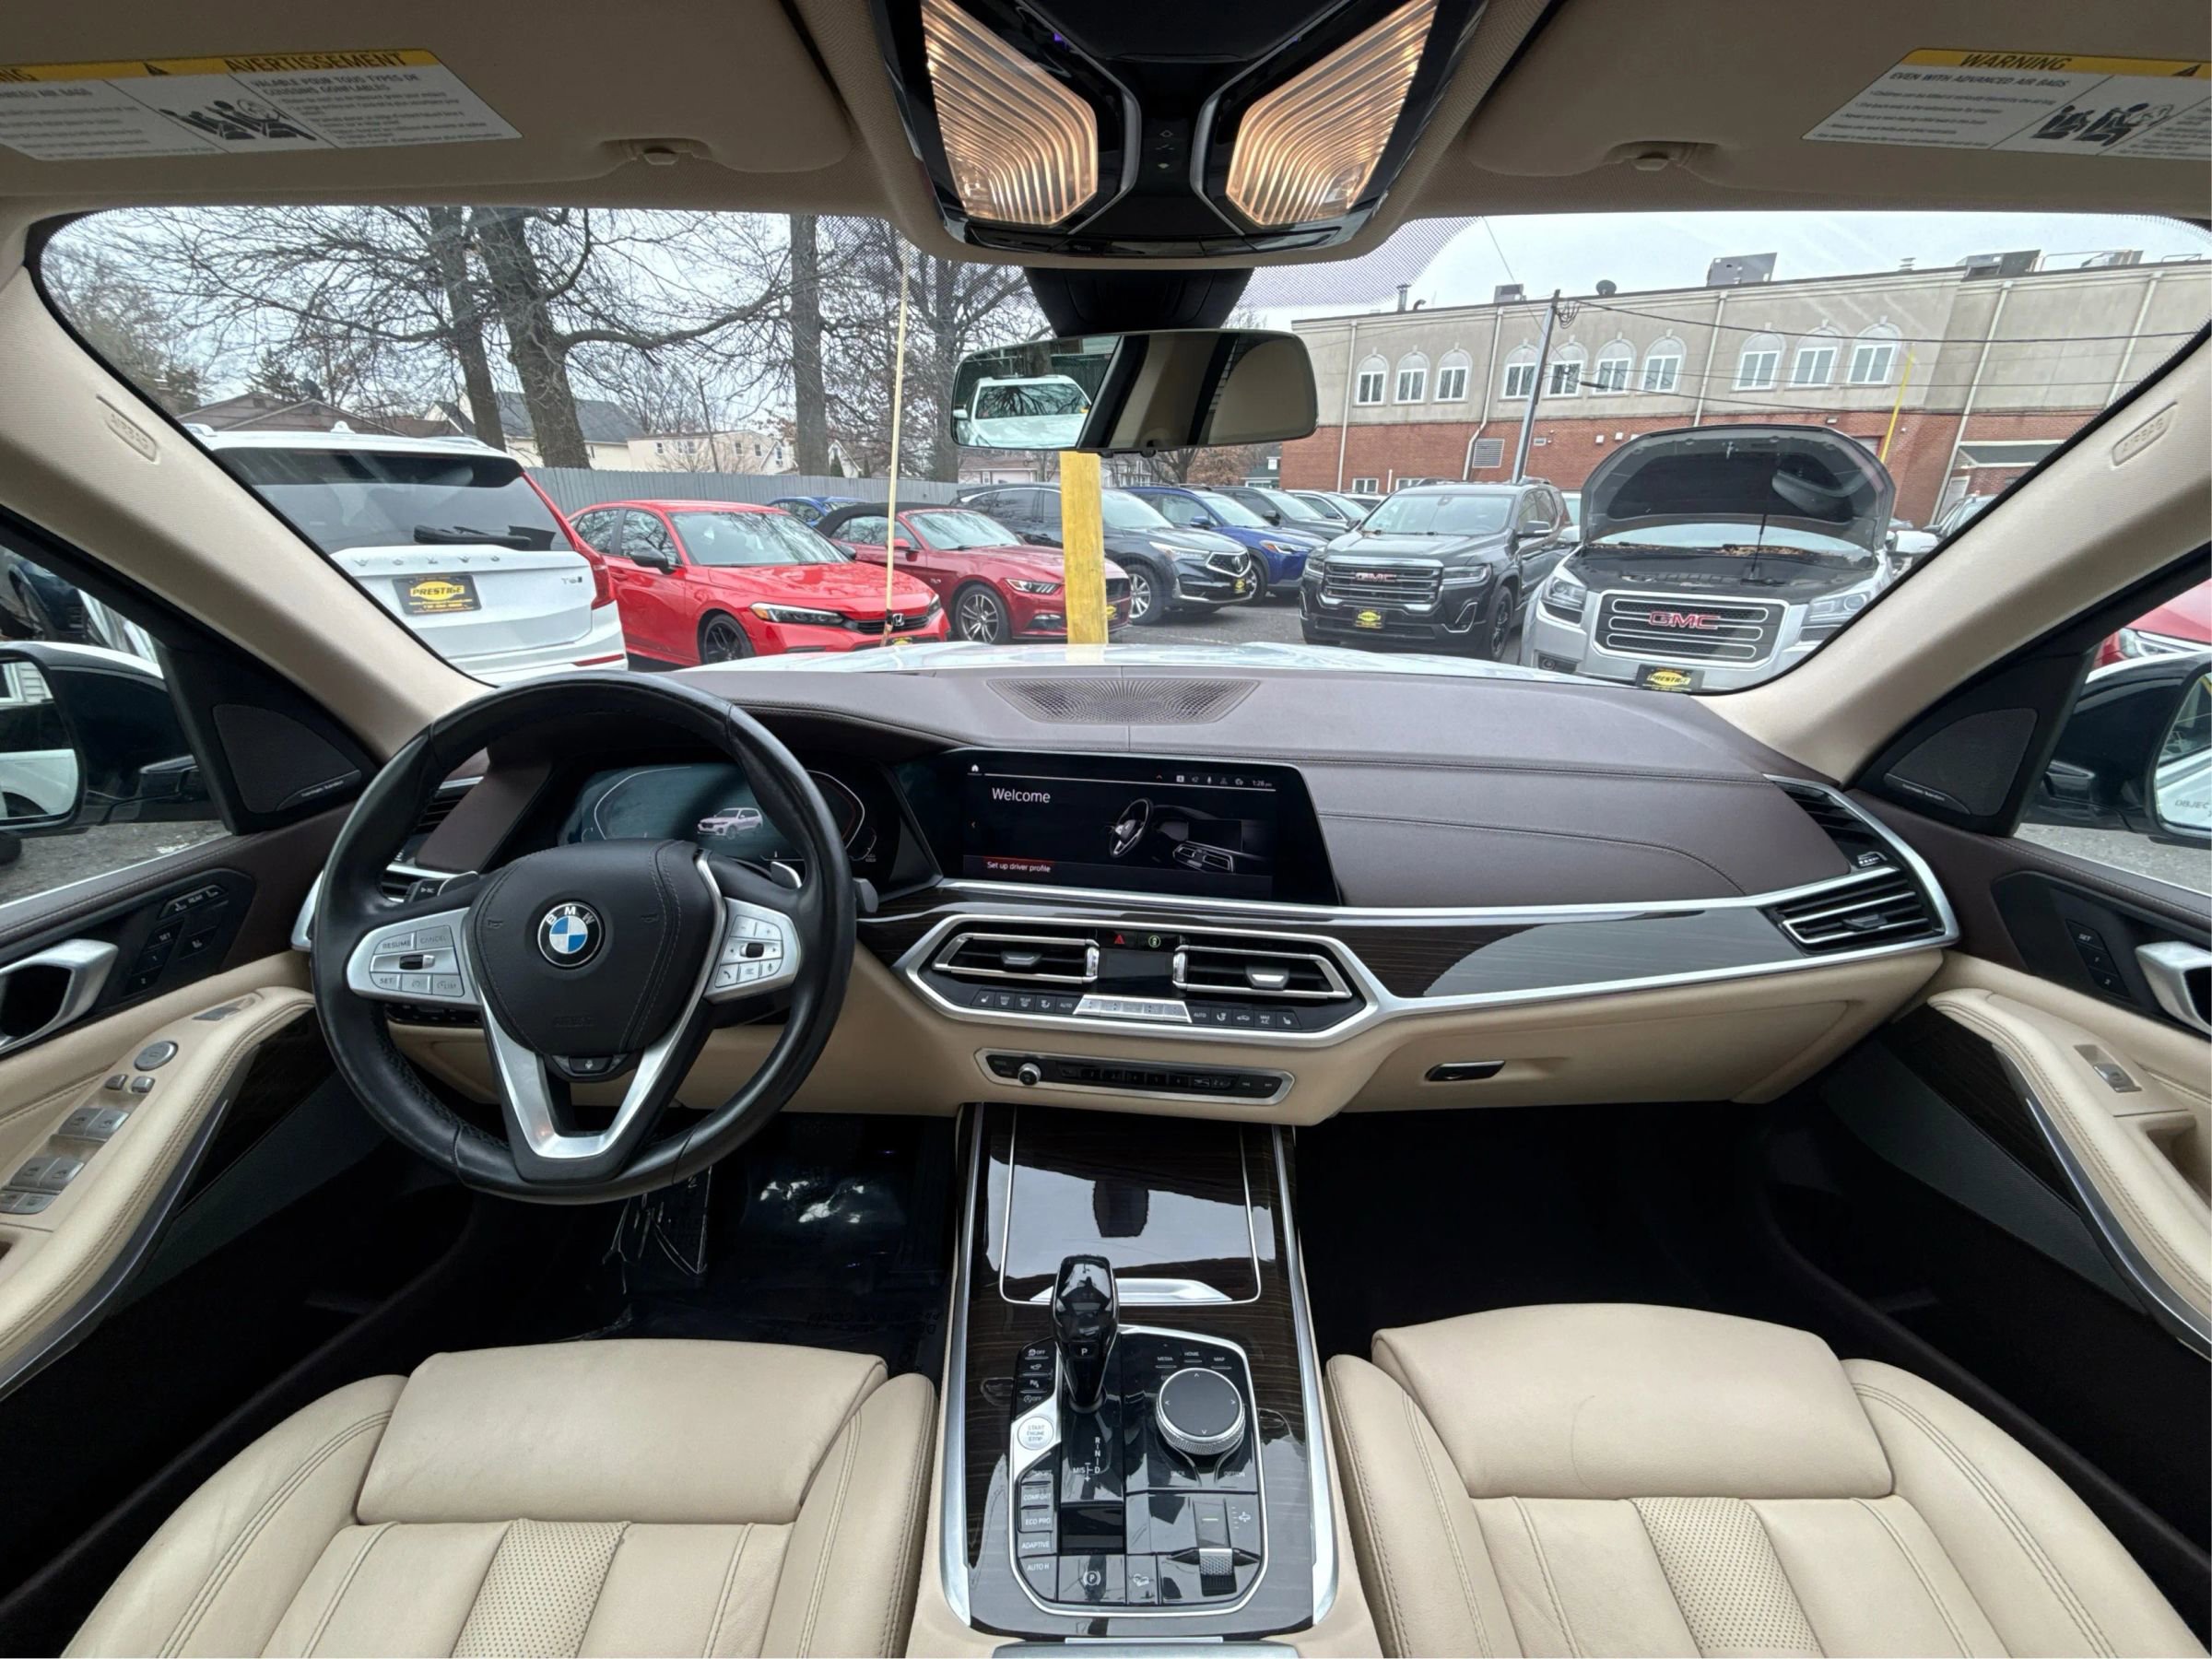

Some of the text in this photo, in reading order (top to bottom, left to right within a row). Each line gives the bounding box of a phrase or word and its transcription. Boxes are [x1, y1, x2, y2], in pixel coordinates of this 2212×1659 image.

[224, 53, 408, 73] AVERTISSEMENT
[1959, 53, 2072, 71] WARNING
[1889, 72, 1922, 81] EVEN
[1922, 74, 1953, 82] WITH
[1953, 75, 2015, 85] ADVANCED
[412, 586, 463, 596] PRESTIGE
[1648, 610, 1721, 630] GMC
[991, 787, 1051, 804] Welcome
[2174, 799, 2210, 809] OBJEC
[986, 861, 998, 869] Set
[1009, 863, 1028, 871] driver
[1029, 865, 1052, 873] profile
[545, 906, 595, 926] BMW
[382, 940, 411, 949] RESUME
[1080, 1347, 1088, 1357] P
[1094, 1436, 1101, 1444] R
[1094, 1450, 1101, 1458] N
[1094, 1465, 1101, 1474] D
[1021, 1540, 1050, 1549] ADAPTIVE
[1027, 1563, 1043, 1571] AUTO
